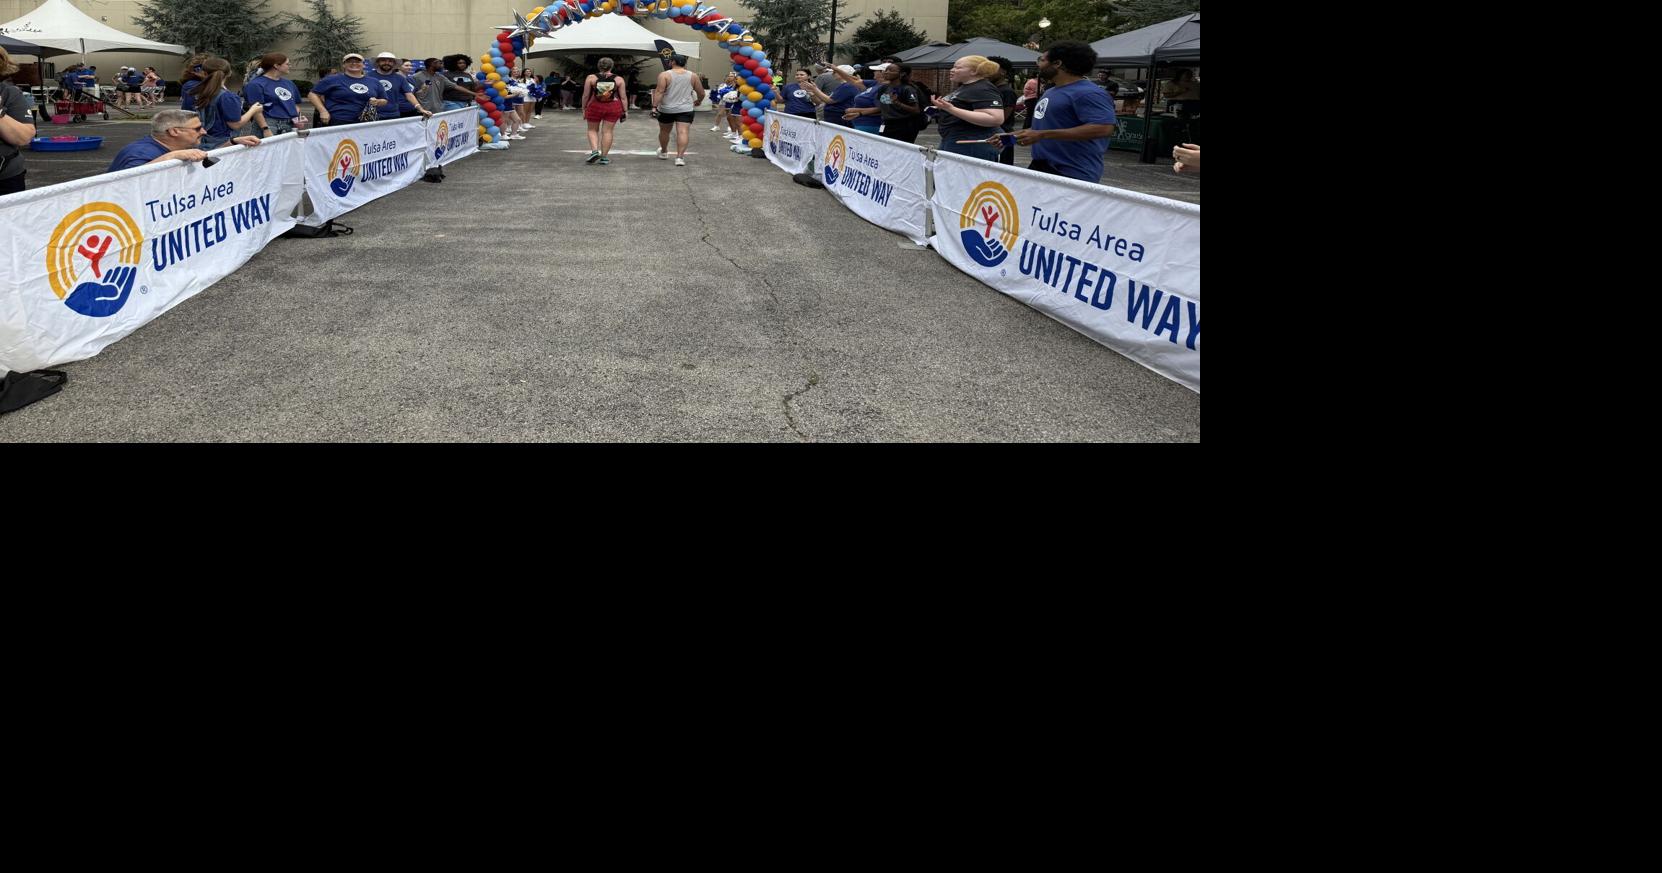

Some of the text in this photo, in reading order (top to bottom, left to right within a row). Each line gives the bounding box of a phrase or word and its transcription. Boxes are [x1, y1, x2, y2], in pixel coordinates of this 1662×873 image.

[360, 151, 410, 183] UNITED WAY
[363, 139, 396, 156] Tulsa Area
[849, 146, 879, 170] Tulsa Area
[145, 181, 234, 222] Tulsa Area
[841, 166, 894, 208] UNITED WAY
[151, 193, 271, 272] UNITED WAY
[1030, 205, 1146, 263] Tulsa Area
[1018, 239, 1200, 351] UNITED WAY
